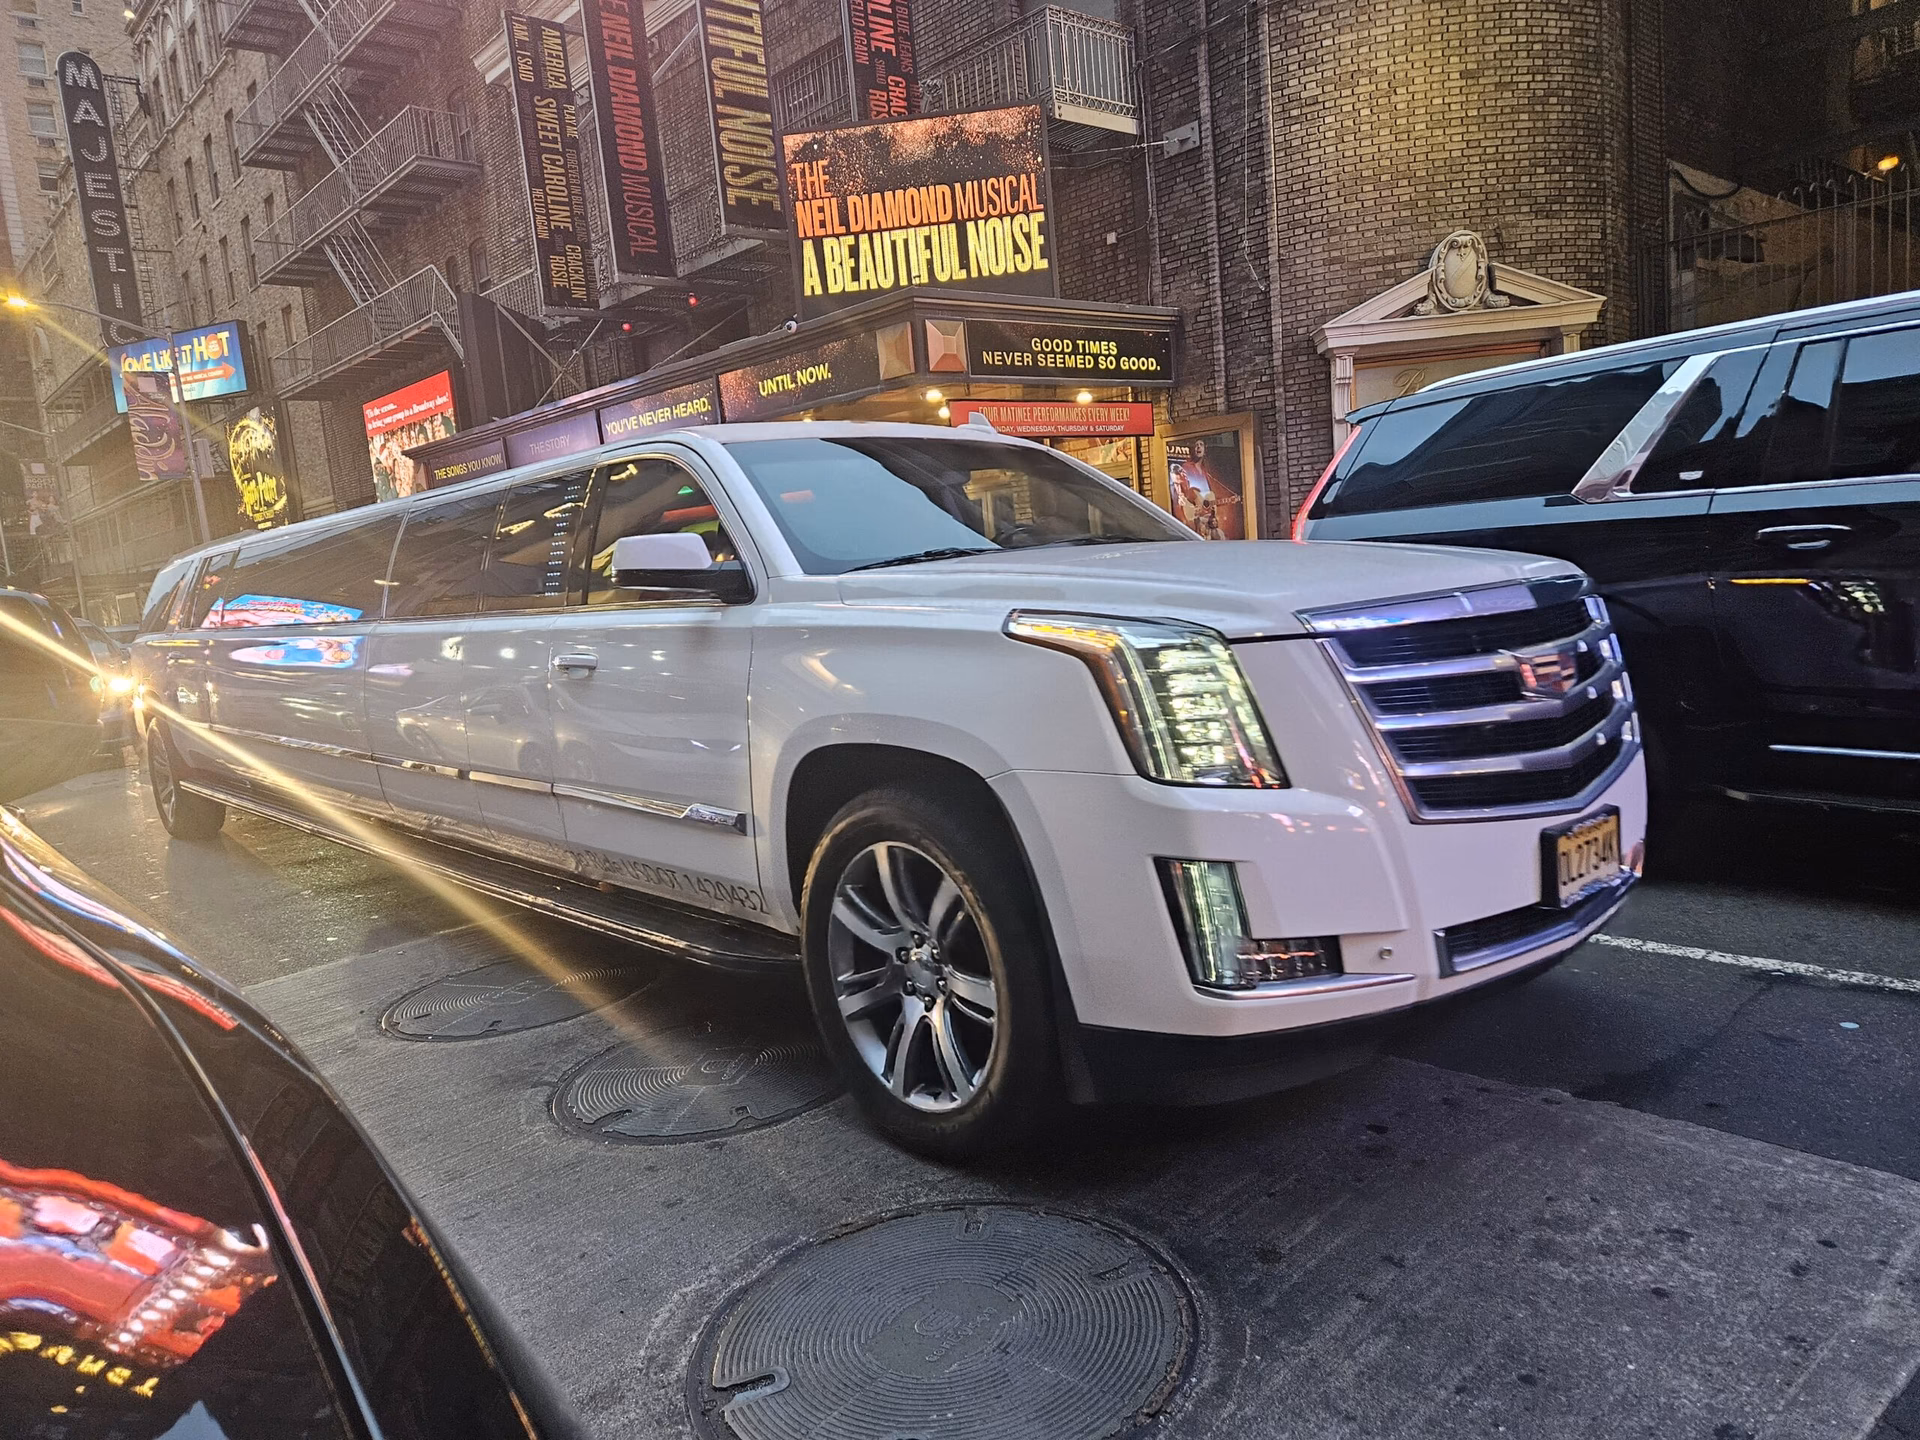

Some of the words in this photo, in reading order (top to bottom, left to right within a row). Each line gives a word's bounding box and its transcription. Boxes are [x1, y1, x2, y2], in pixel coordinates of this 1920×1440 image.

[513, 22, 529, 47] AM...
[600, 11, 635, 60] NEIL
[896, 5, 910, 36] BLUE
[541, 25, 568, 89] AMERICA
[853, 27, 869, 65] AGAIN
[899, 36, 914, 74] JEANS
[517, 56, 534, 82] SAID
[875, 58, 887, 85] SHILO
[534, 95, 563, 152] SWEET
[563, 104, 576, 125] PLAY
[607, 64, 648, 171] DIAMOND
[566, 125, 579, 140] ME
[565, 148, 581, 186] FOREVER
[716, 104, 781, 211] NOISE
[541, 152, 573, 232] CAROLINE
[570, 186, 583, 194] IN
[791, 159, 832, 200] THE
[65, 60, 138, 345] MAJESTIC
[531, 187, 546, 213] HELLO
[572, 194, 585, 215] BLUE
[620, 172, 658, 257] MUSICAL
[795, 196, 846, 238] NEIL
[847, 183, 952, 233] DIAMOND
[954, 173, 1044, 221] MUSICAL
[535, 213, 550, 239] AGAIN
[574, 215, 588, 243] JEANS
[802, 238, 824, 297] A
[822, 222, 968, 294] BEAUTIFUL
[966, 211, 1049, 278] NOISE
[550, 255, 569, 289] ROSIE
[565, 244, 588, 302] CRACKLIN'
[121, 353, 153, 372] SOME
[192, 331, 230, 362] HOT
[982, 351, 1033, 366] NEVER
[1037, 353, 1094, 369] SEEMED
[1098, 355, 1117, 370] SO
[1119, 357, 1161, 371] GOOD.
[1031, 337, 1073, 353] GOOD
[1076, 339, 1118, 355] TIMES
[758, 372, 796, 397] UNTIL
[796, 363, 832, 386] NOW.
[605, 416, 638, 436] YOU'VE
[638, 407, 672, 427] NEVER
[672, 397, 712, 419] HEARD.
[1000, 406, 1031, 421] MATINEE
[1033, 407, 1087, 422] PERFORMANCES
[1087, 407, 1109, 421] EVERY
[1109, 407, 1130, 421] WEEK!
[1016, 425, 1056, 433] WEDNESDAY,
[529, 441, 545, 455] THE
[545, 434, 570, 452] STORY
[434, 469, 447, 480] THE
[446, 464, 468, 478] SONGS
[467, 460, 481, 472] YOU
[481, 453, 503, 470] KNOW.
[619, 858, 684, 890] USDOT
[683, 874, 770, 915] 1420432
